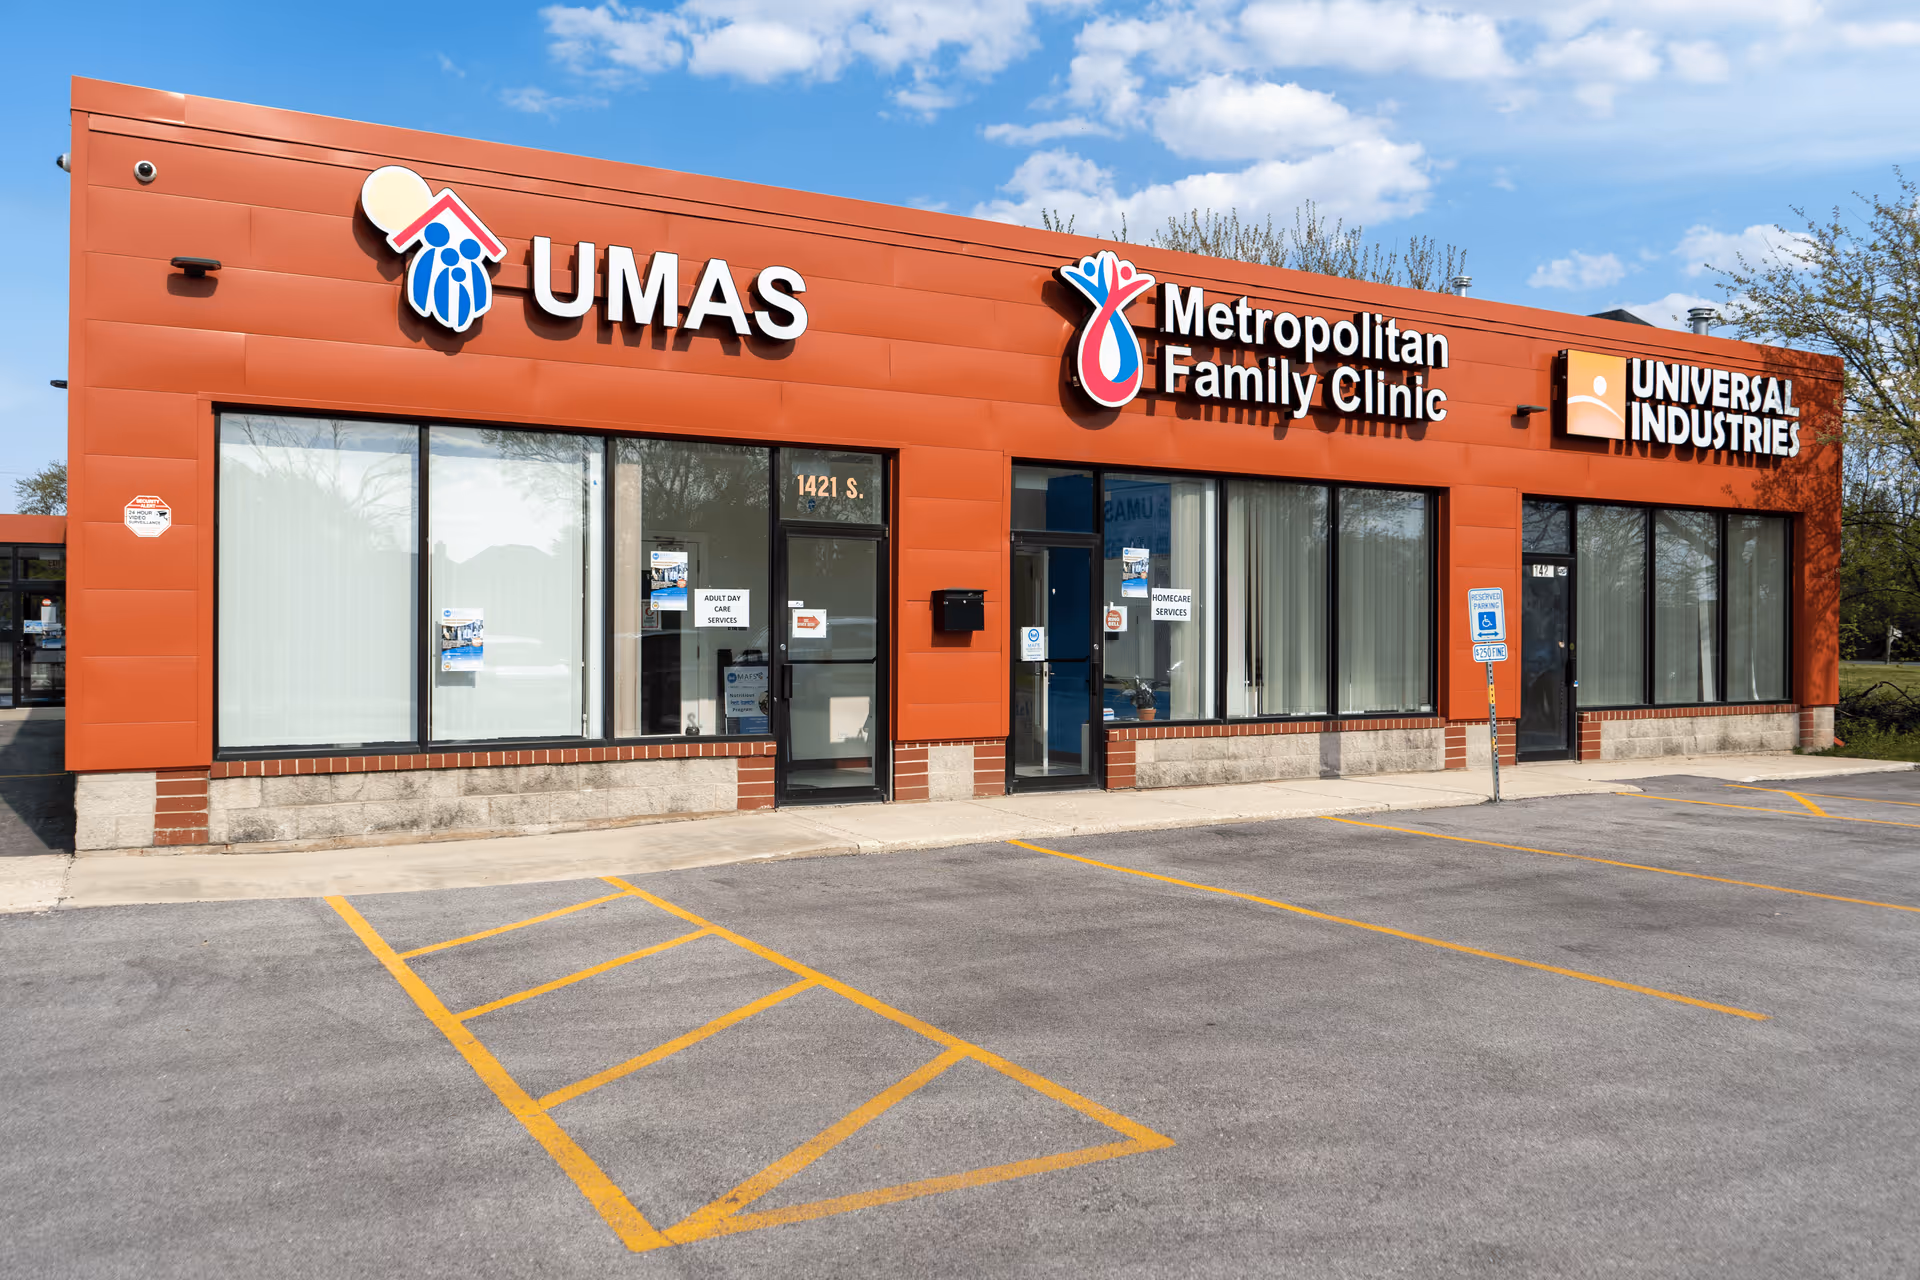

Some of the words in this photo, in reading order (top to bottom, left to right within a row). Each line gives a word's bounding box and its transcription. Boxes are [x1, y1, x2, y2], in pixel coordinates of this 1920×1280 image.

[531, 235, 809, 341] UMAS
[1164, 282, 1449, 369] Metropolitan
[1164, 344, 1317, 419] Family
[1331, 365, 1449, 422] Clinic
[1632, 357, 1800, 417] UNIVERSAL
[1631, 400, 1801, 458] INDUSTRIES
[797, 474, 837, 498] 1421
[846, 477, 864, 499] S.
[1152, 594, 1191, 603] HOMECARE
[1155, 607, 1188, 616] SERVICES
[1471, 593, 1501, 601] RESERVED
[1475, 647, 1491, 658] $250
[1492, 646, 1505, 657] FINE
